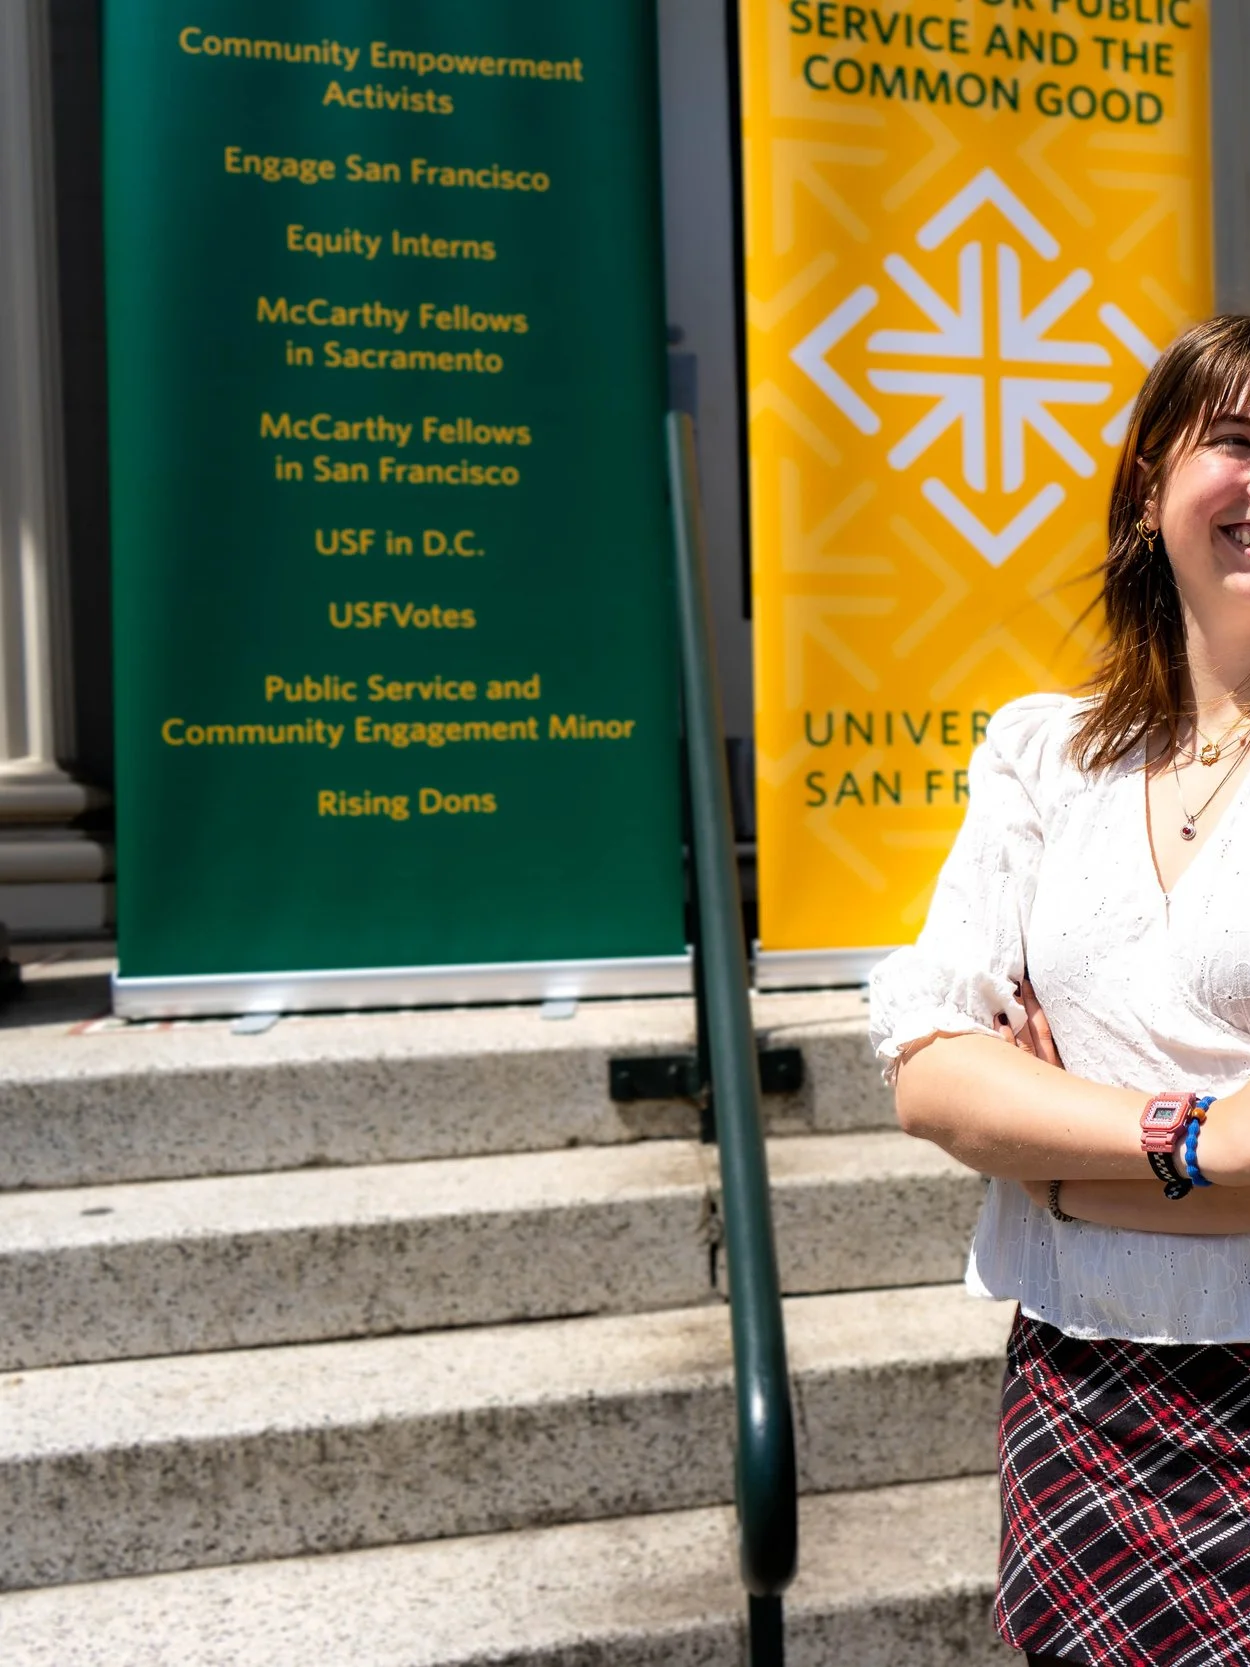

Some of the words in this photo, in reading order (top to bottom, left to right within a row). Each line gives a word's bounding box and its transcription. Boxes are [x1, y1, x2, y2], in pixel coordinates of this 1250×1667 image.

[179, 27, 360, 71] Community
[370, 41, 583, 81] Empowerment
[789, 0, 970, 55] SERVICE
[984, 24, 1079, 67] AND
[1092, 36, 1175, 77] THE
[322, 81, 454, 115] Activists
[802, 54, 1020, 113] COMMON
[1034, 82, 1164, 126] GOOD
[224, 146, 336, 185] Engage
[346, 155, 401, 183] San
[410, 159, 550, 193] Francisco
[286, 224, 381, 260] Equity
[391, 231, 496, 261] Interns
[256, 296, 410, 334] McCarthy
[419, 303, 529, 333] Fellows
[285, 340, 314, 366] in
[323, 341, 504, 373] Sacramento
[260, 412, 412, 448] McCarthy
[422, 416, 532, 446] Fellows
[275, 455, 303, 481] in
[313, 455, 369, 483] San
[378, 457, 520, 486] Francisco
[314, 529, 375, 556] USF
[385, 529, 412, 556] in
[422, 530, 486, 557] D.C.
[328, 601, 477, 629] USFVotes
[264, 675, 357, 702] Public
[366, 675, 477, 701] Service
[485, 673, 541, 700] and
[161, 717, 345, 749] Community
[354, 715, 540, 749] Engagement
[548, 714, 636, 740] Minor
[317, 790, 410, 821] Rising
[418, 788, 497, 815] Dons
[804, 770, 903, 808] SAN
